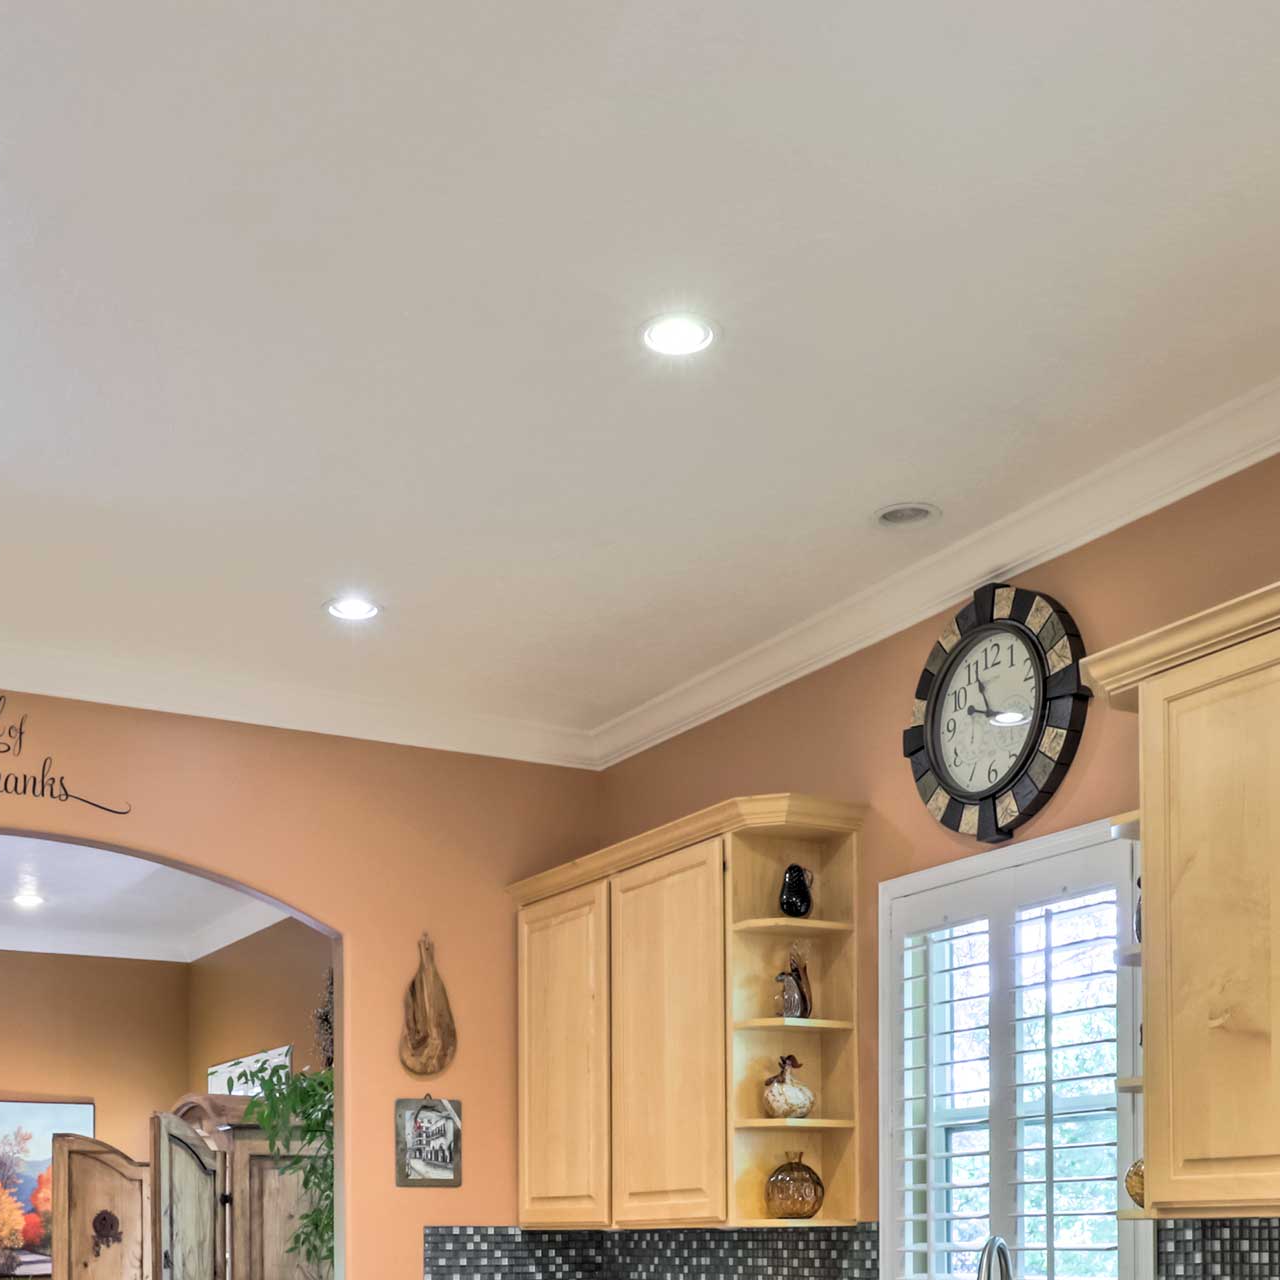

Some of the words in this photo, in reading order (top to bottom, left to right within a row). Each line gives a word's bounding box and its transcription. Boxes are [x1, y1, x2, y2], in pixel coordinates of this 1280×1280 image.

[981, 643, 1001, 671] 12
[1007, 644, 1016, 668] 1
[964, 660, 980, 687] 11
[951, 686, 968, 713] 10
[8, 713, 28, 757] of
[946, 718, 957, 742] 9
[987, 760, 998, 784] 6
